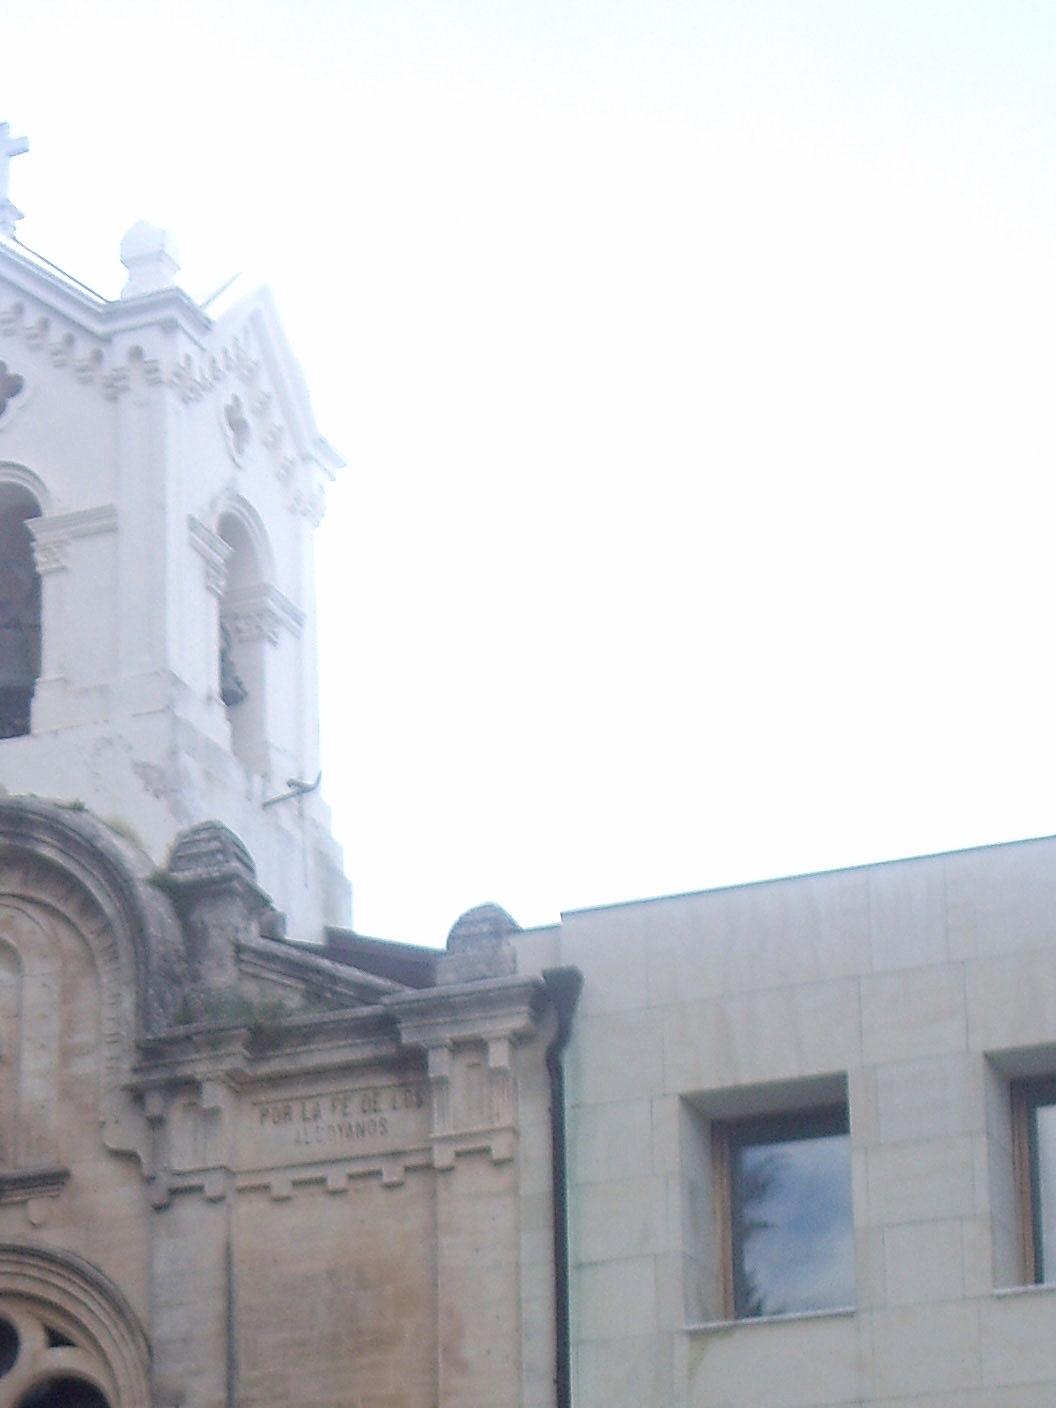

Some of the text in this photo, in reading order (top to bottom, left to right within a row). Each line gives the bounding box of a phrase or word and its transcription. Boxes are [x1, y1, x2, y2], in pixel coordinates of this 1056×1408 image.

[259, 1103, 292, 1127] POR
[301, 1101, 323, 1122] LA
[360, 1089, 382, 1115] DE
[391, 1087, 424, 1111] LOS
